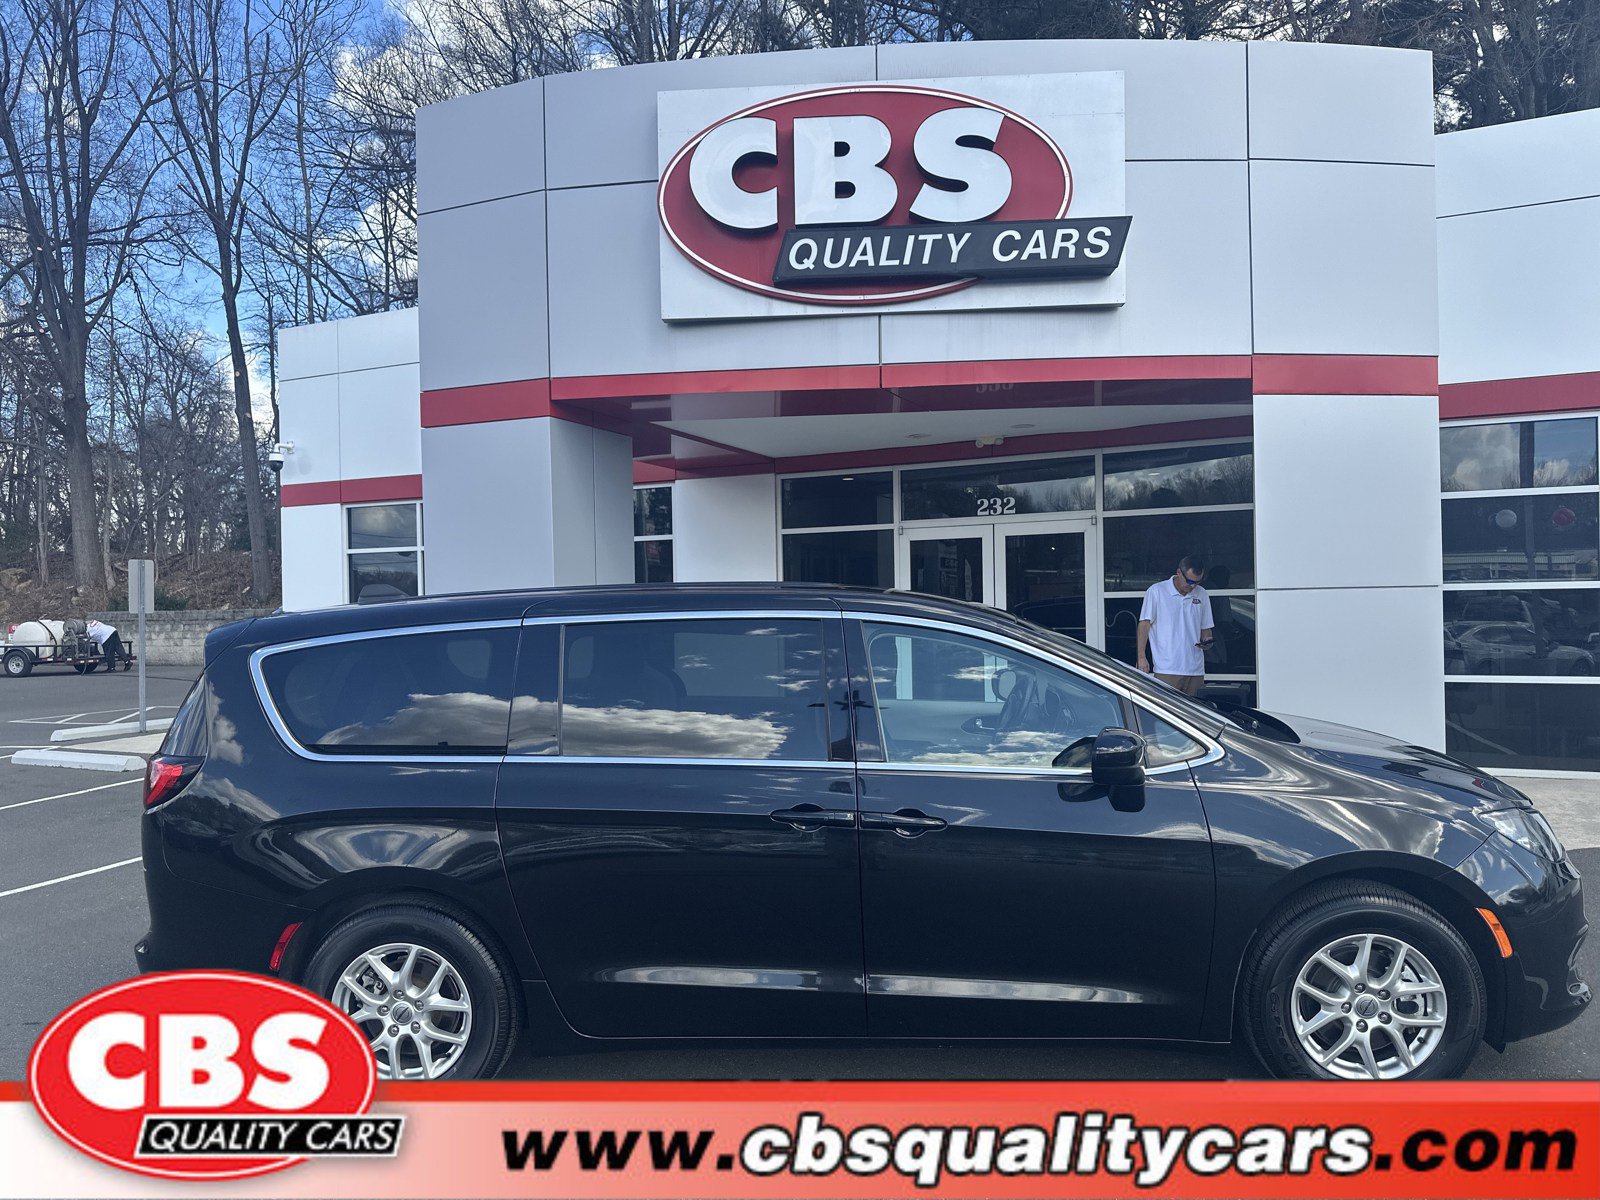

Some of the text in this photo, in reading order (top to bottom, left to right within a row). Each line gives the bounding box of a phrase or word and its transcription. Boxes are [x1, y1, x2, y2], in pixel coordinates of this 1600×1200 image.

[689, 107, 1013, 231] CBS
[788, 226, 1112, 270] QUALITY CARS
[977, 497, 1016, 516] 232
